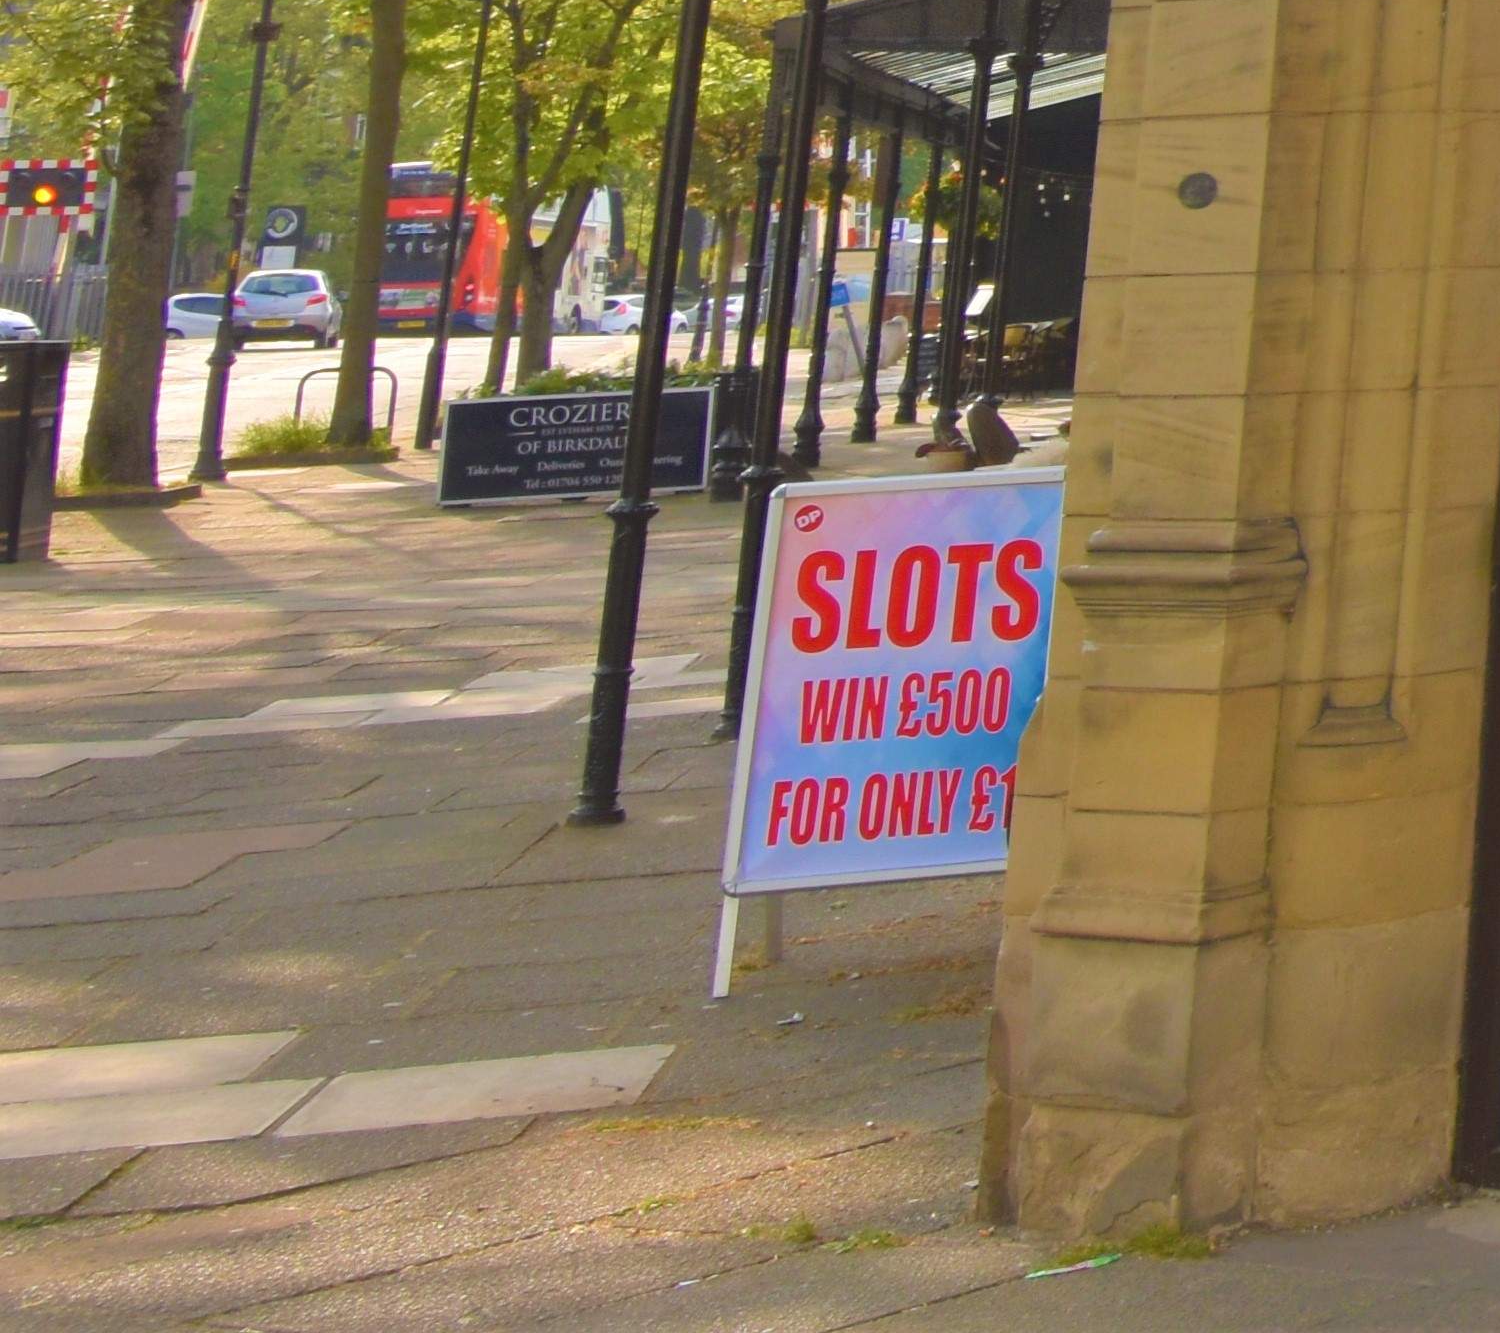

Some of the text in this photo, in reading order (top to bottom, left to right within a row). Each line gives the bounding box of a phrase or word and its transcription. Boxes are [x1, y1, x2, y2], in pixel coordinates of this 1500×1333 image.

[465, 464, 490, 477] Take
[491, 463, 520, 477] Away
[536, 459, 586, 472] Deliveries
[516, 441, 543, 455] OF
[795, 507, 822, 528] DP
[790, 538, 1044, 654] SLOTS
[800, 666, 1012, 745] WIN £500
[766, 776, 849, 847] FOR
[857, 767, 963, 841] ONLY
